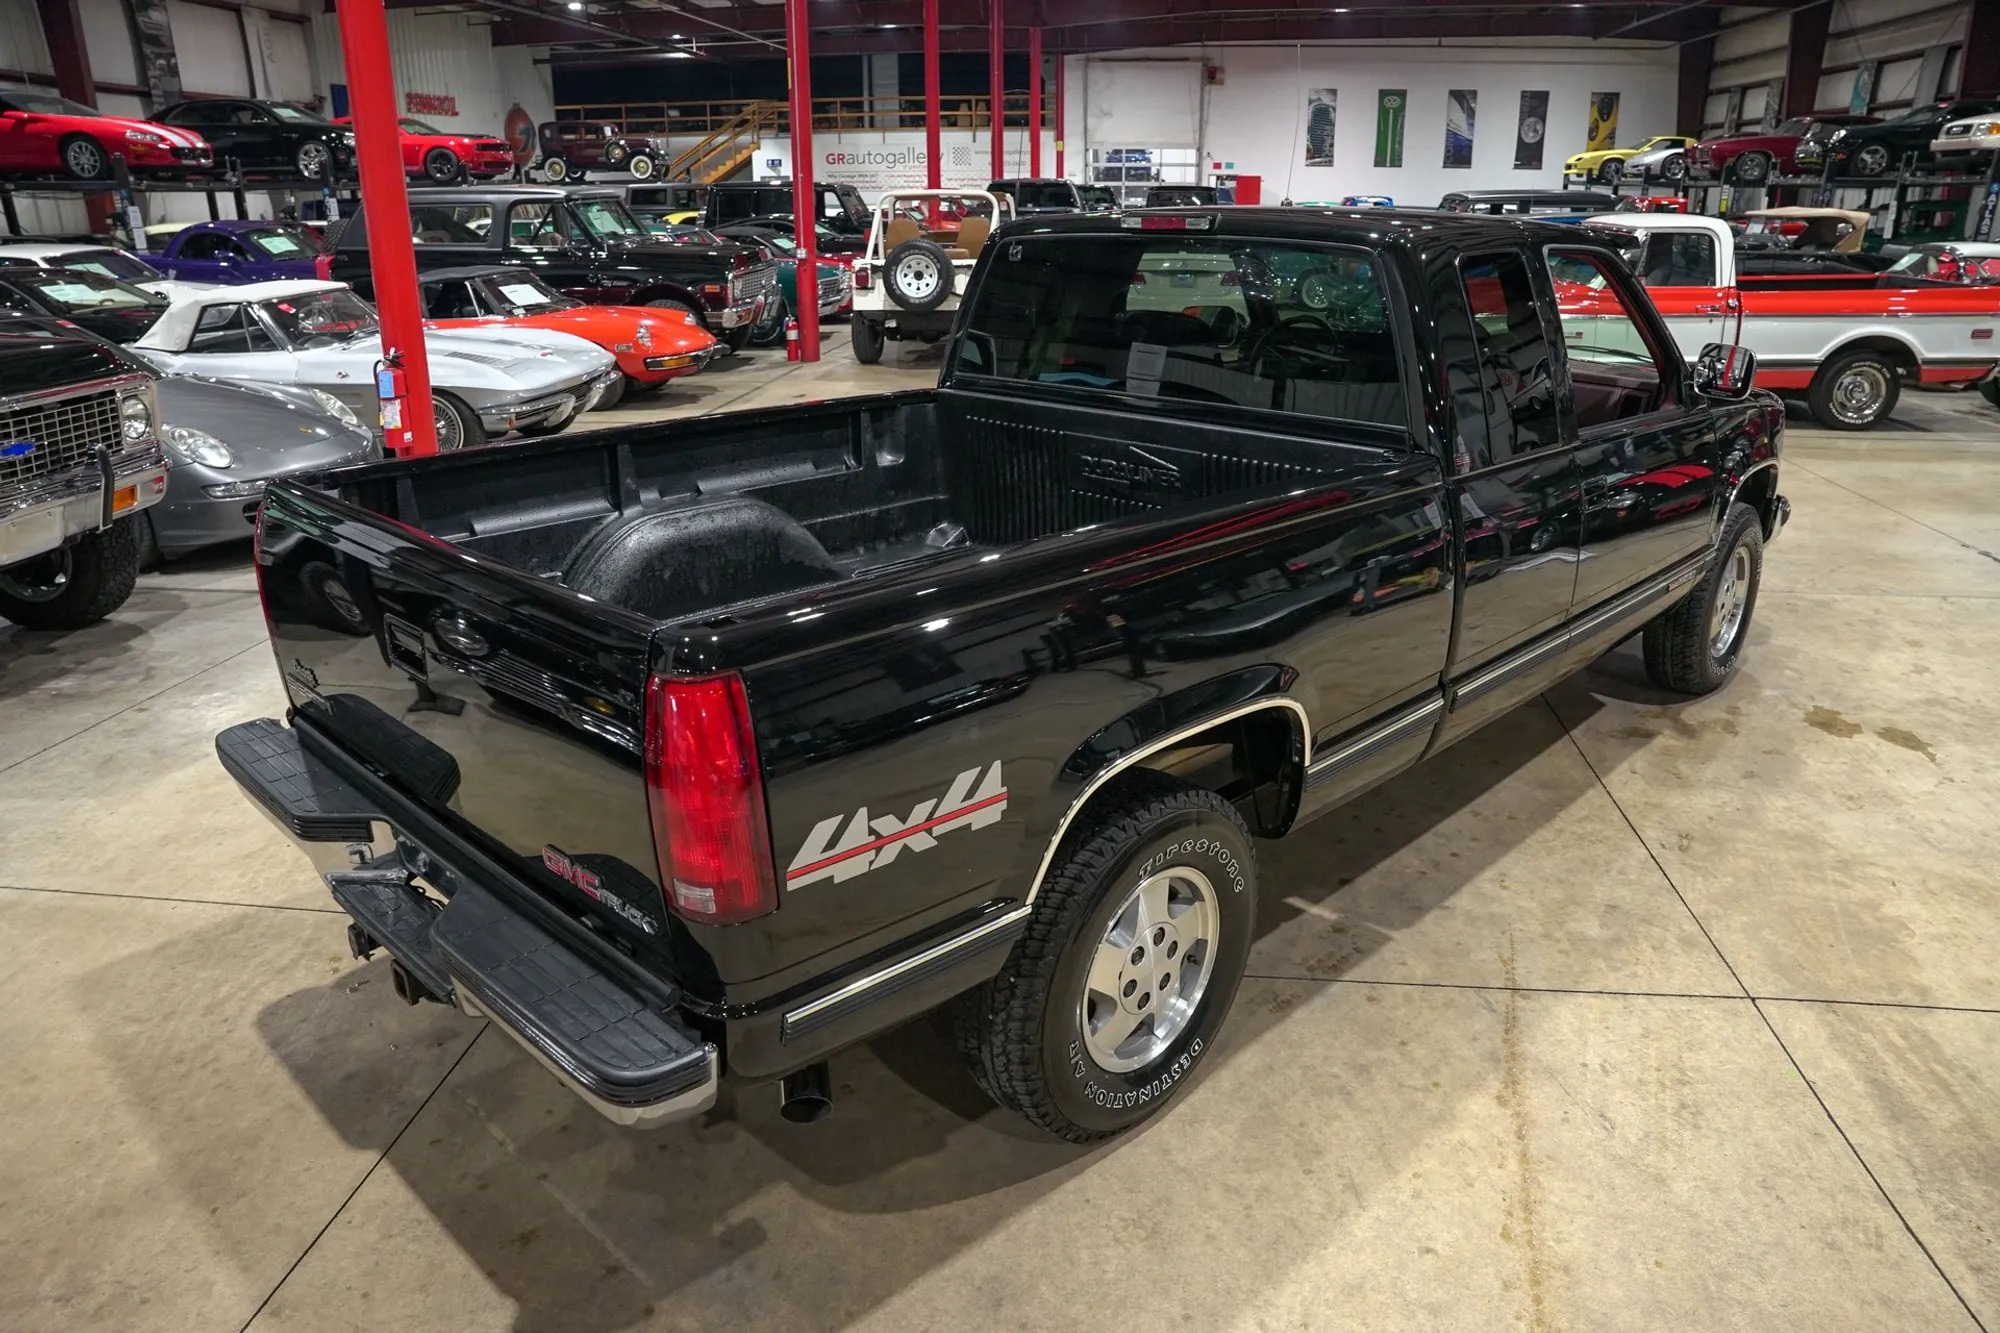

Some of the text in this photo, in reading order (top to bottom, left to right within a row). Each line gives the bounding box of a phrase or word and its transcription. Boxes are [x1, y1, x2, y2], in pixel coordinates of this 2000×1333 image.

[826, 146, 944, 169] GRautogalle
[1980, 194, 1997, 234] ATLAS
[542, 846, 658, 935] GMC TRUCK
[1139, 839, 1244, 892] Firestone
[1069, 1038, 1204, 1108] DESTINATION A/T
